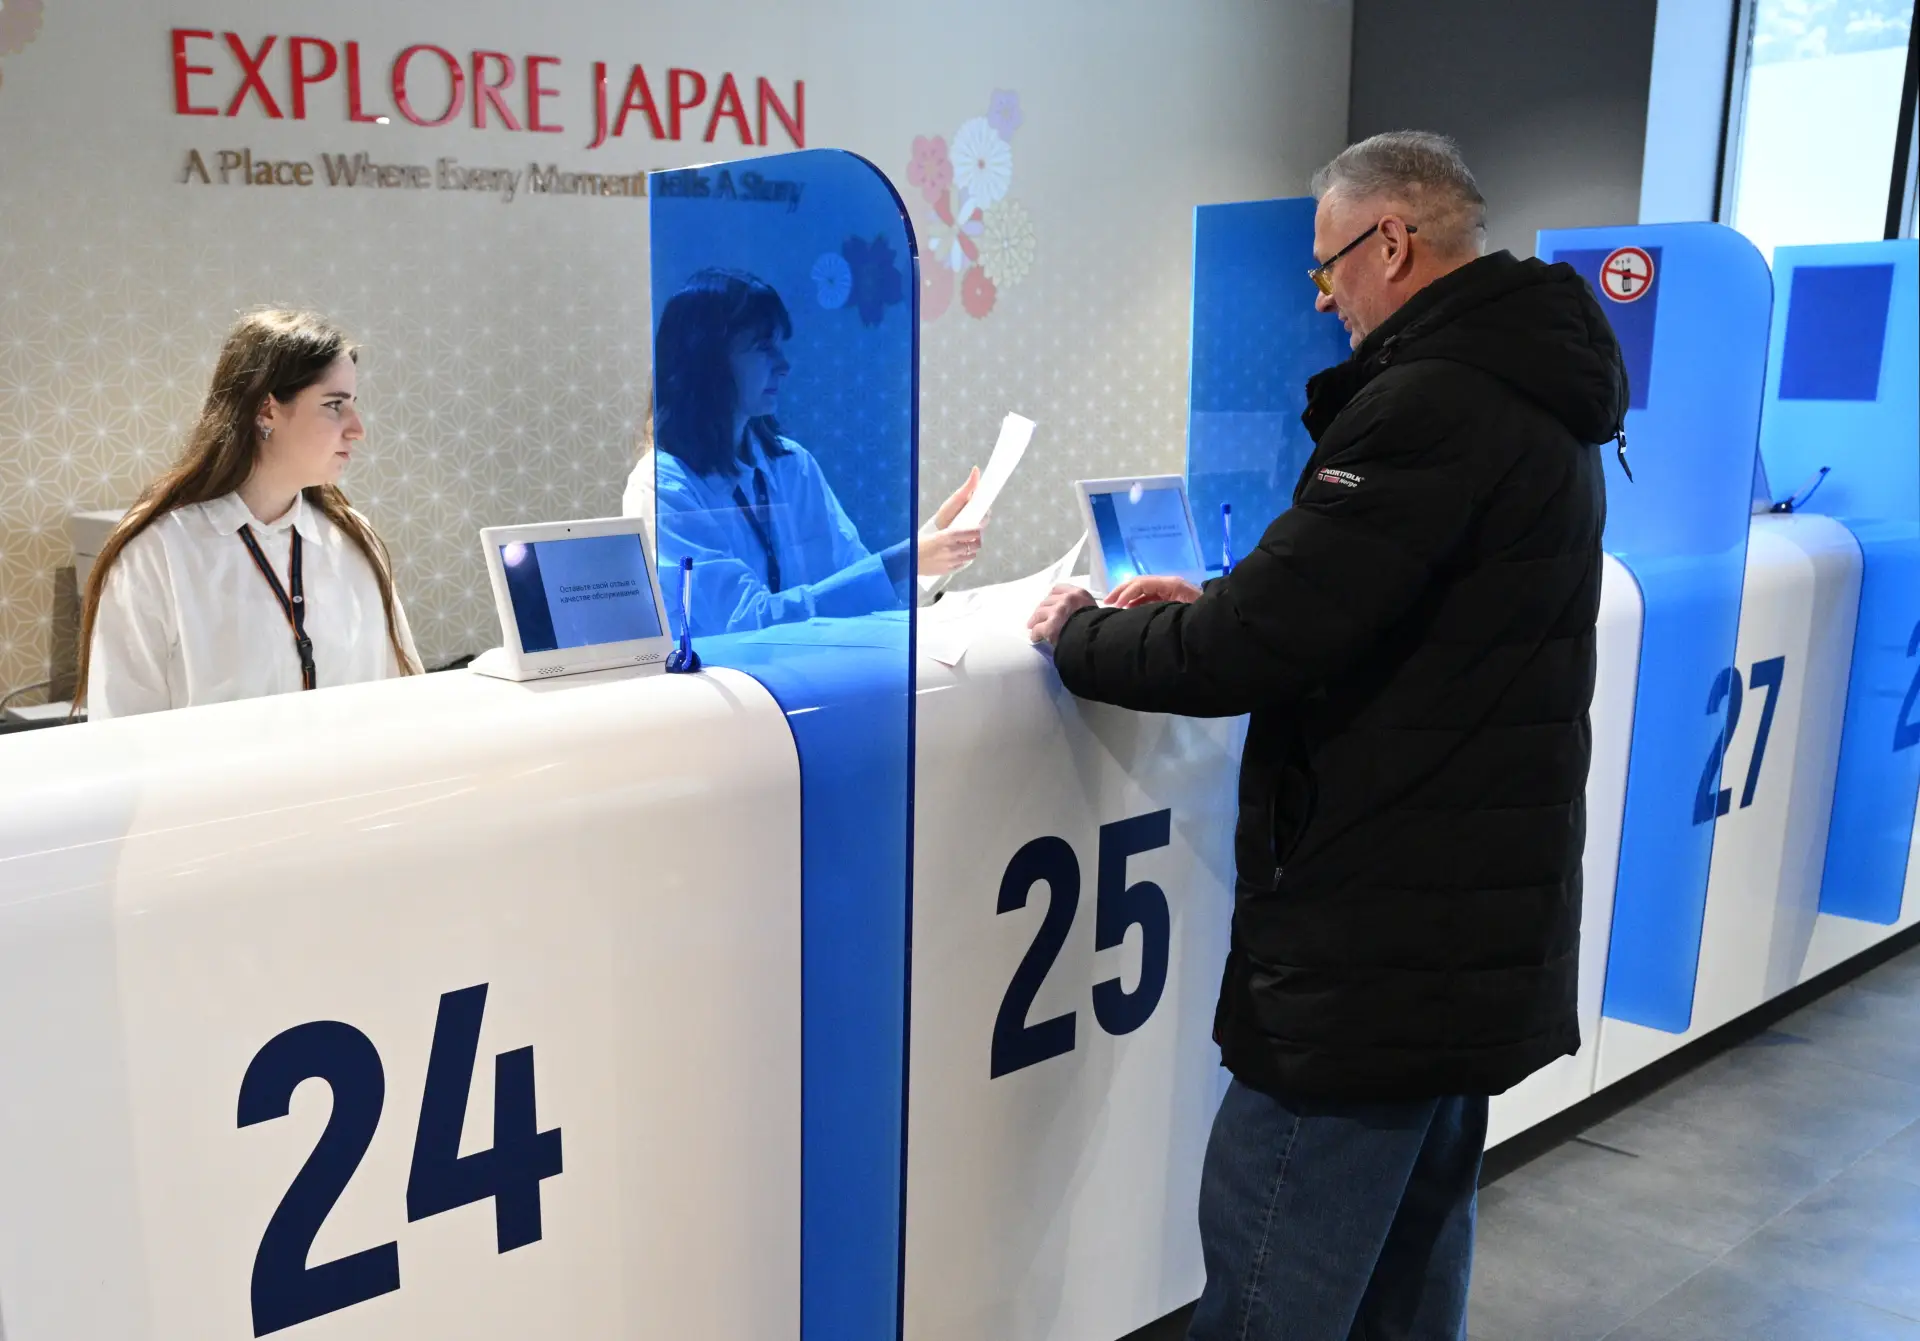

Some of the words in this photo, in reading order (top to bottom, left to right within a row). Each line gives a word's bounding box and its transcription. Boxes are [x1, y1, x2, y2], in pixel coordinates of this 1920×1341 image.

[171, 28, 565, 133] EXPLORE
[584, 60, 806, 149] JAPAN
[181, 148, 211, 184] A
[216, 148, 314, 187] Place
[320, 151, 432, 189] Where
[435, 156, 522, 203] Every
[527, 161, 646, 197] Moment
[713, 168, 737, 200] A
[1339, 478, 1358, 488] Norge
[560, 584, 591, 593] Оставьте
[592, 581, 609, 590] свой
[609, 580, 630, 588] отзыв
[560, 594, 591, 603] качестве
[592, 589, 640, 600] обслуживания
[1692, 655, 1785, 827] 27
[990, 808, 1171, 1080] 25
[236, 982, 563, 1339] 24
